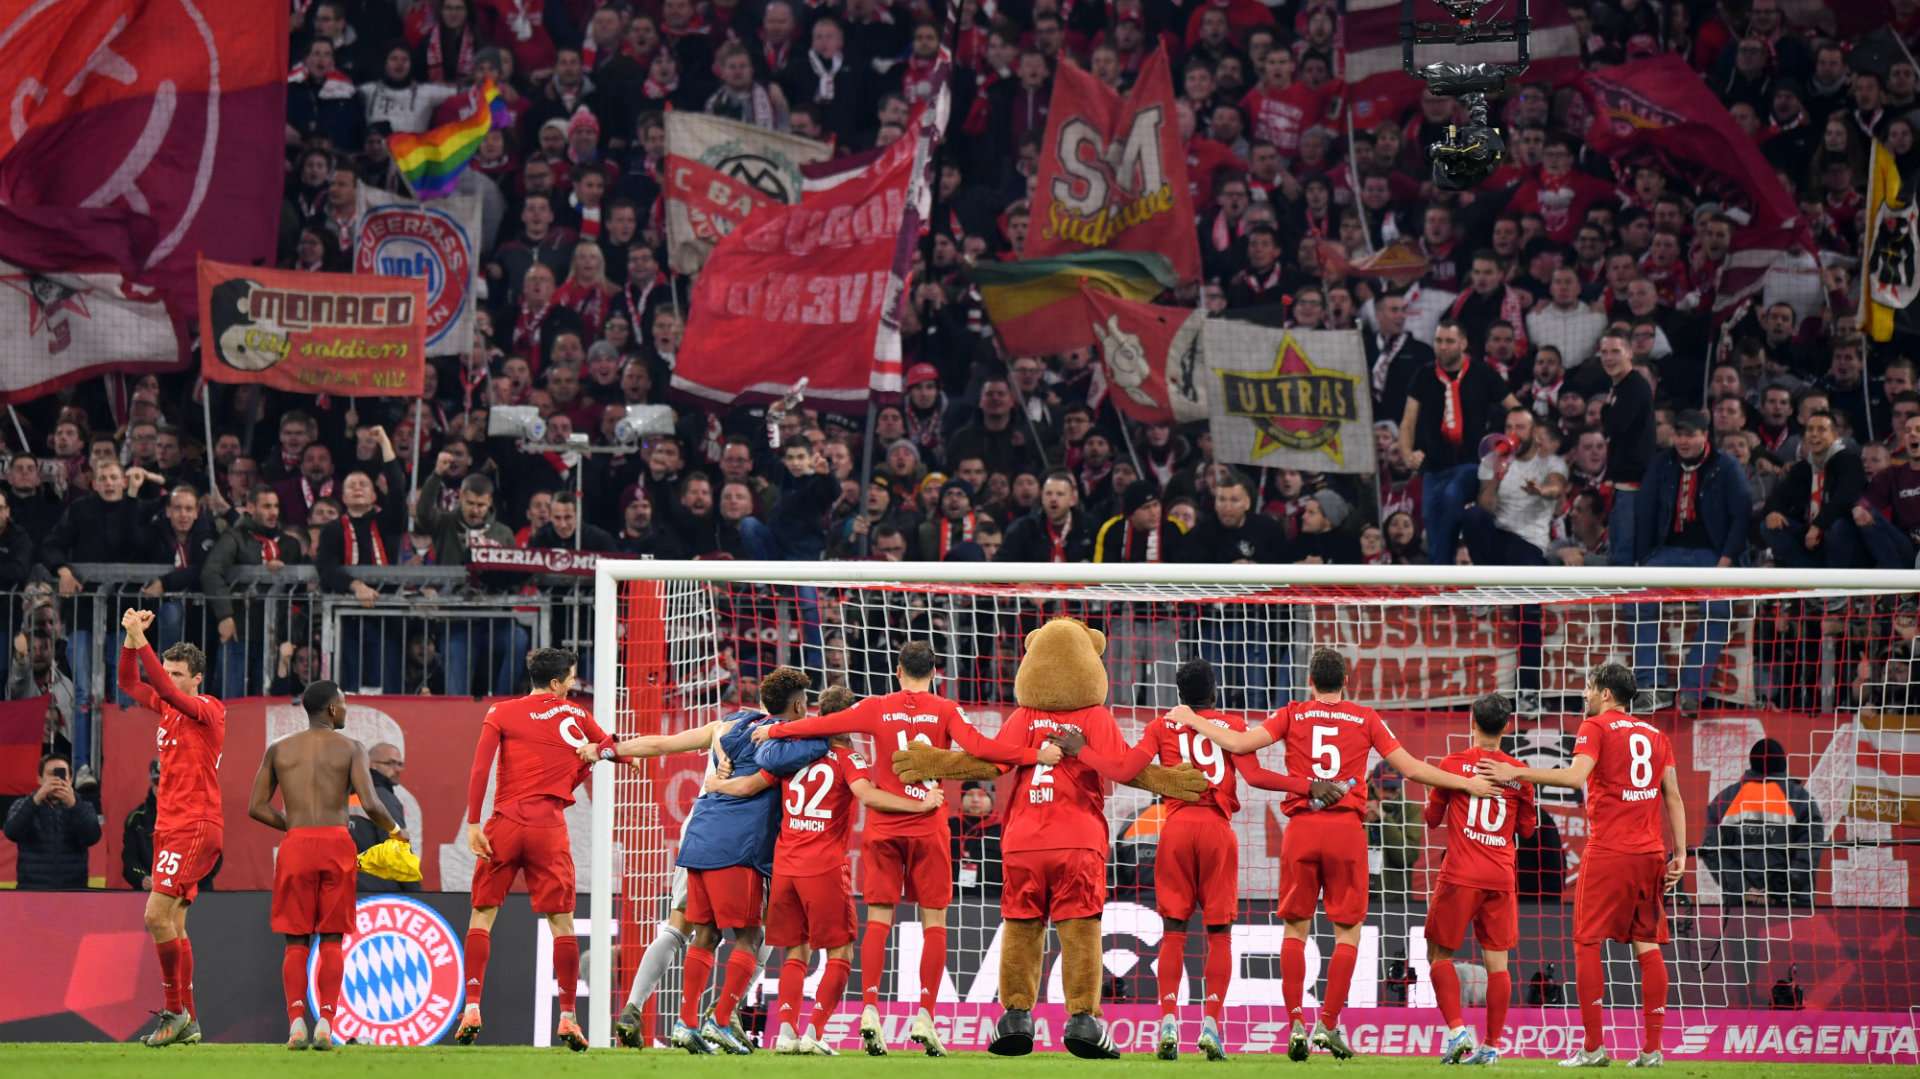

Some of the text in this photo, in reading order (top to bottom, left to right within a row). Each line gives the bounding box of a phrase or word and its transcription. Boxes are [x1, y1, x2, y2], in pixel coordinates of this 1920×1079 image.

[362, 216, 463, 269] QUEERPASS
[249, 288, 415, 332] MONACO
[1237, 379, 1347, 417] ULTRAS
[1178, 732, 1225, 785] 19
[1311, 725, 1341, 779] 5
[1629, 733, 1653, 788] 8
[785, 763, 834, 819] 32
[904, 784, 928, 800] GOR
[1029, 787, 1054, 803] BENI
[1622, 787, 1659, 802] MARTÍNE
[789, 817, 825, 832] KIMMICH
[1467, 795, 1507, 832] 10
[156, 850, 182, 875] 25
[356, 907, 453, 967] BAYERN
[1723, 1025, 1920, 1054] MAGENTA
